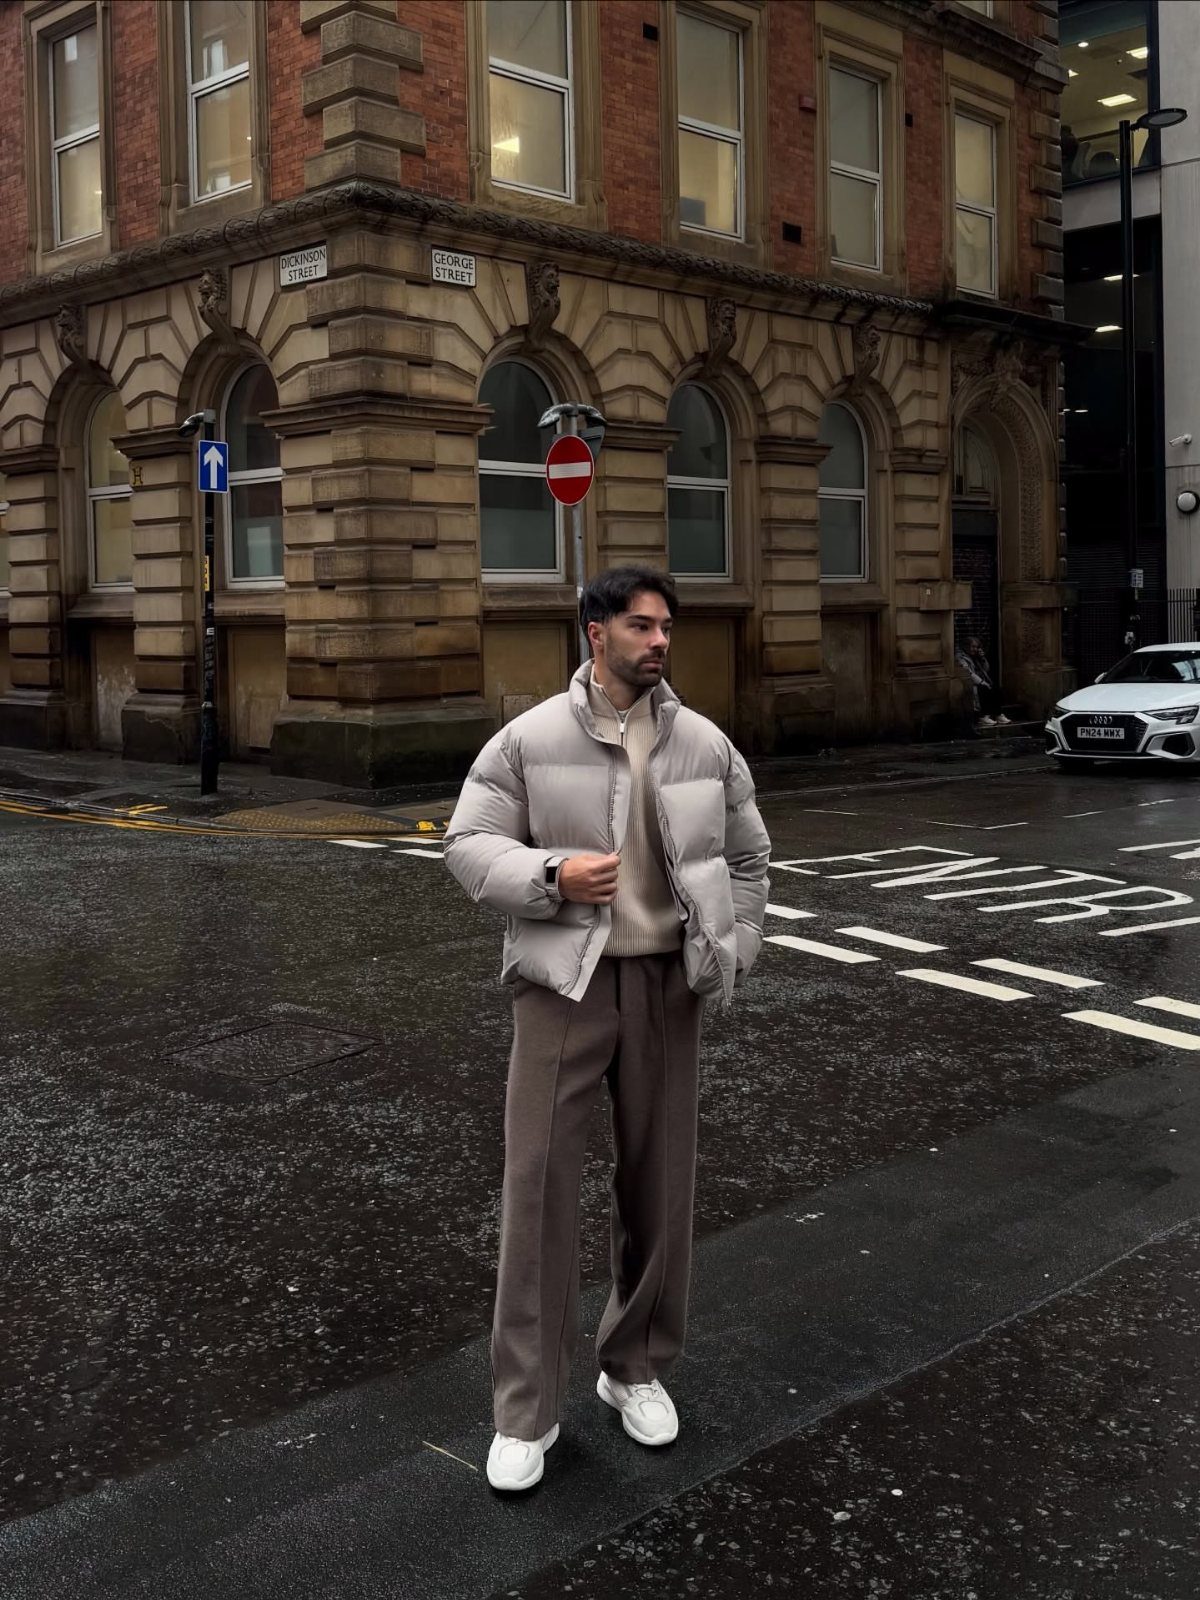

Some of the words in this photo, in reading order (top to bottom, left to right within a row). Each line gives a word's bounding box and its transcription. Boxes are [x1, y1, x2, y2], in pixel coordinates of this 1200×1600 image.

[281, 249, 326, 269] DICKINSON
[433, 252, 474, 270] GEORGE
[288, 264, 319, 282] STREET
[435, 267, 473, 283] STREET
[1080, 728, 1101, 737] PN24
